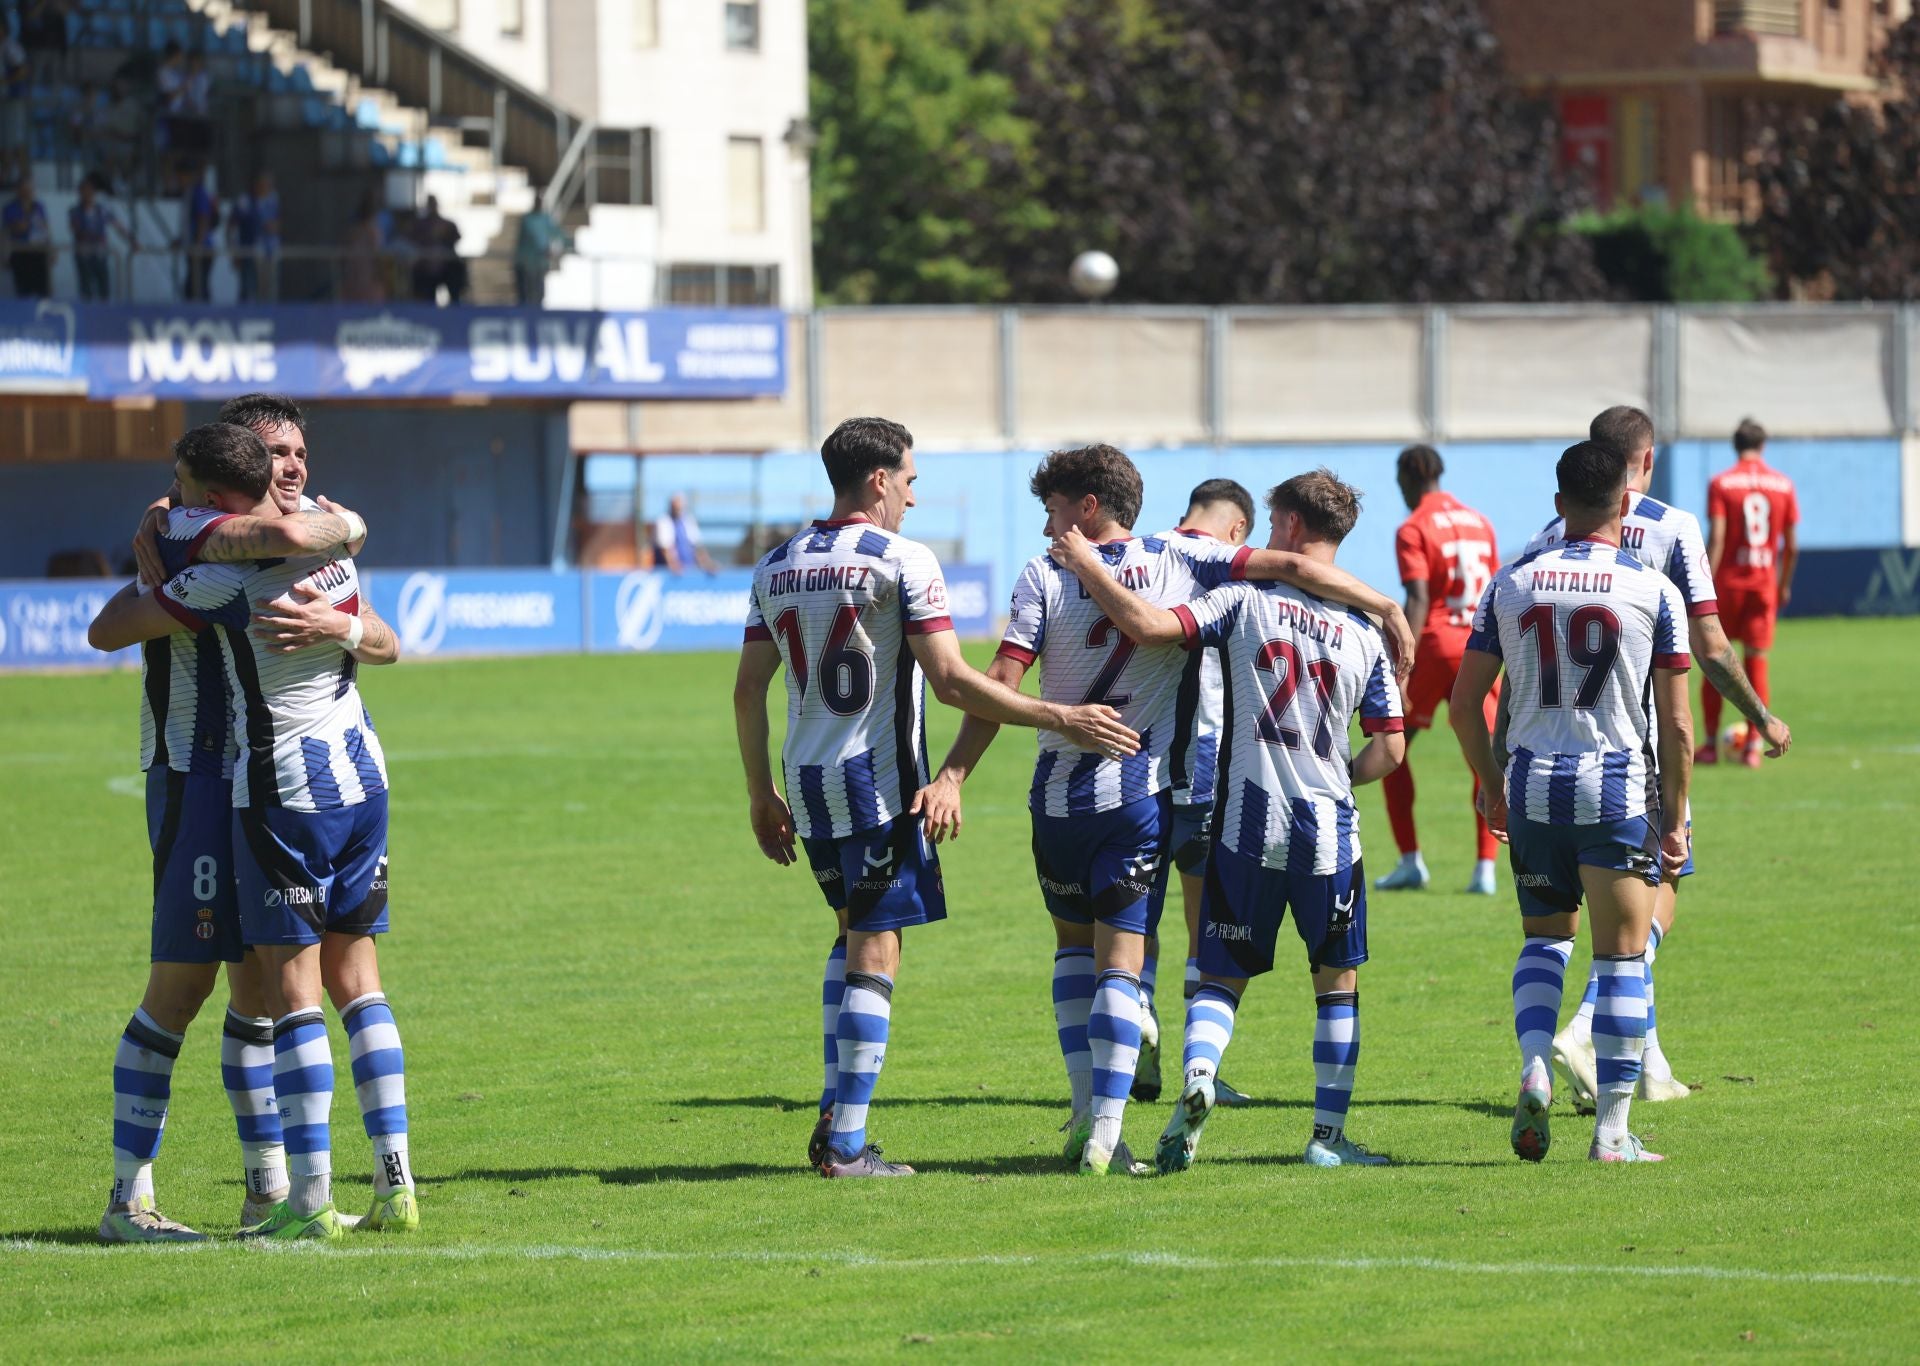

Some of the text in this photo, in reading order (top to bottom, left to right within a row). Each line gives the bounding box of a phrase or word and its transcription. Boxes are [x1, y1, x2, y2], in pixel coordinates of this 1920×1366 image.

[127, 320, 277, 383] NOONE
[468, 317, 665, 383] SUVAL
[1743, 491, 1771, 546] 8
[769, 564, 870, 598] ADRI GÓMEZ
[1531, 570, 1613, 594] NATALIO
[772, 603, 874, 716] 16
[1081, 614, 1138, 710] 2
[1518, 602, 1622, 710] 19
[1255, 638, 1341, 761] 21
[193, 855, 217, 901] 8
